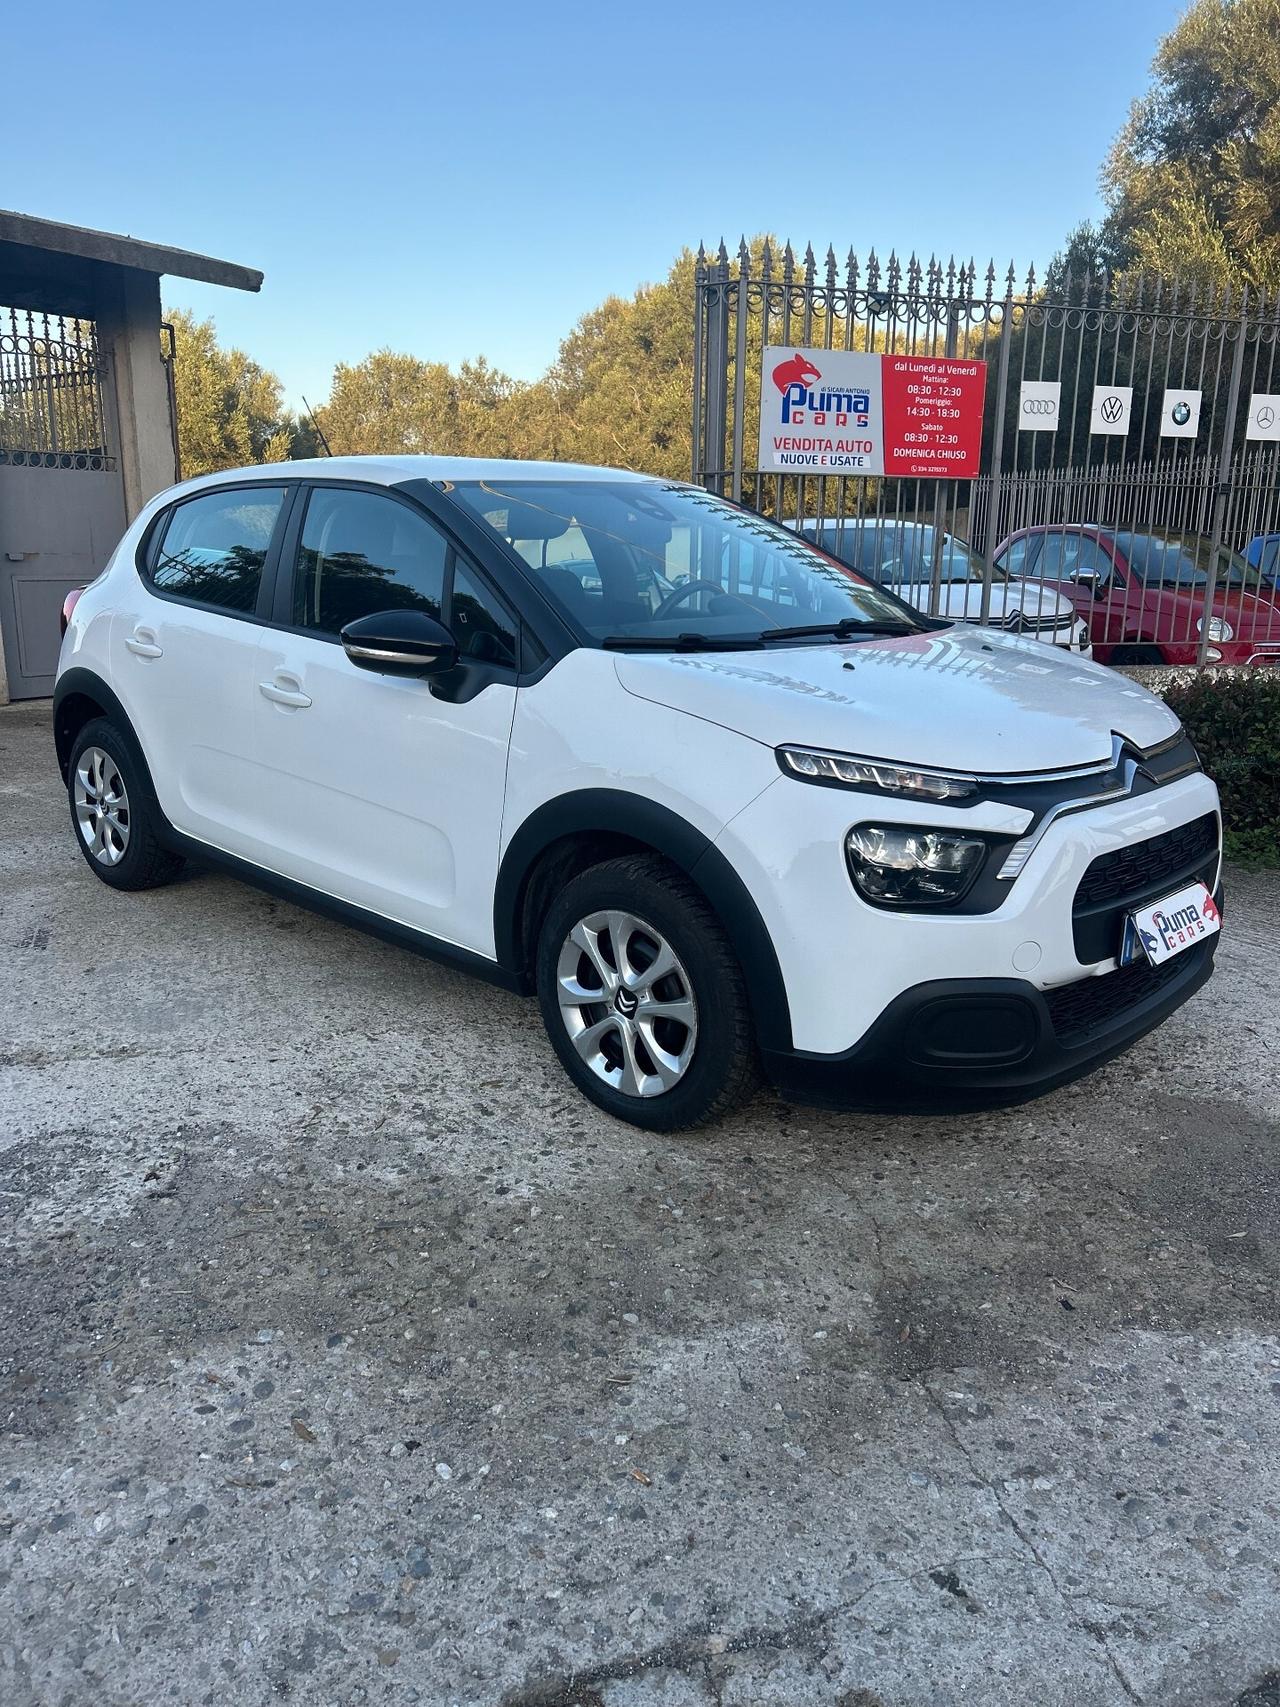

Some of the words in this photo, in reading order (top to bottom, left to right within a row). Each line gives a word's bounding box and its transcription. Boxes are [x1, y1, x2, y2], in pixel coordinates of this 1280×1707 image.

[894, 362, 907, 371] dal
[937, 365, 945, 374] al
[922, 375, 949, 384] Mattina:
[907, 384, 932, 395] 08:30
[939, 386, 962, 397] 12:30
[915, 396, 953, 407] Pomeriggio:
[906, 406, 931, 417] 14:30
[937, 408, 960, 418] 18:30
[921, 422, 944, 431] Sabato
[904, 432, 929, 443] 08:30
[935, 434, 958, 444] 12:30
[774, 437, 833, 452] VENDITA
[835, 439, 873, 453] AUTO
[893, 447, 936, 458] DOMENICA
[937, 449, 967, 460] CHIUSO
[780, 453, 819, 465] NUOVE
[820, 455, 827, 465] E
[830, 456, 864, 467] USATE
